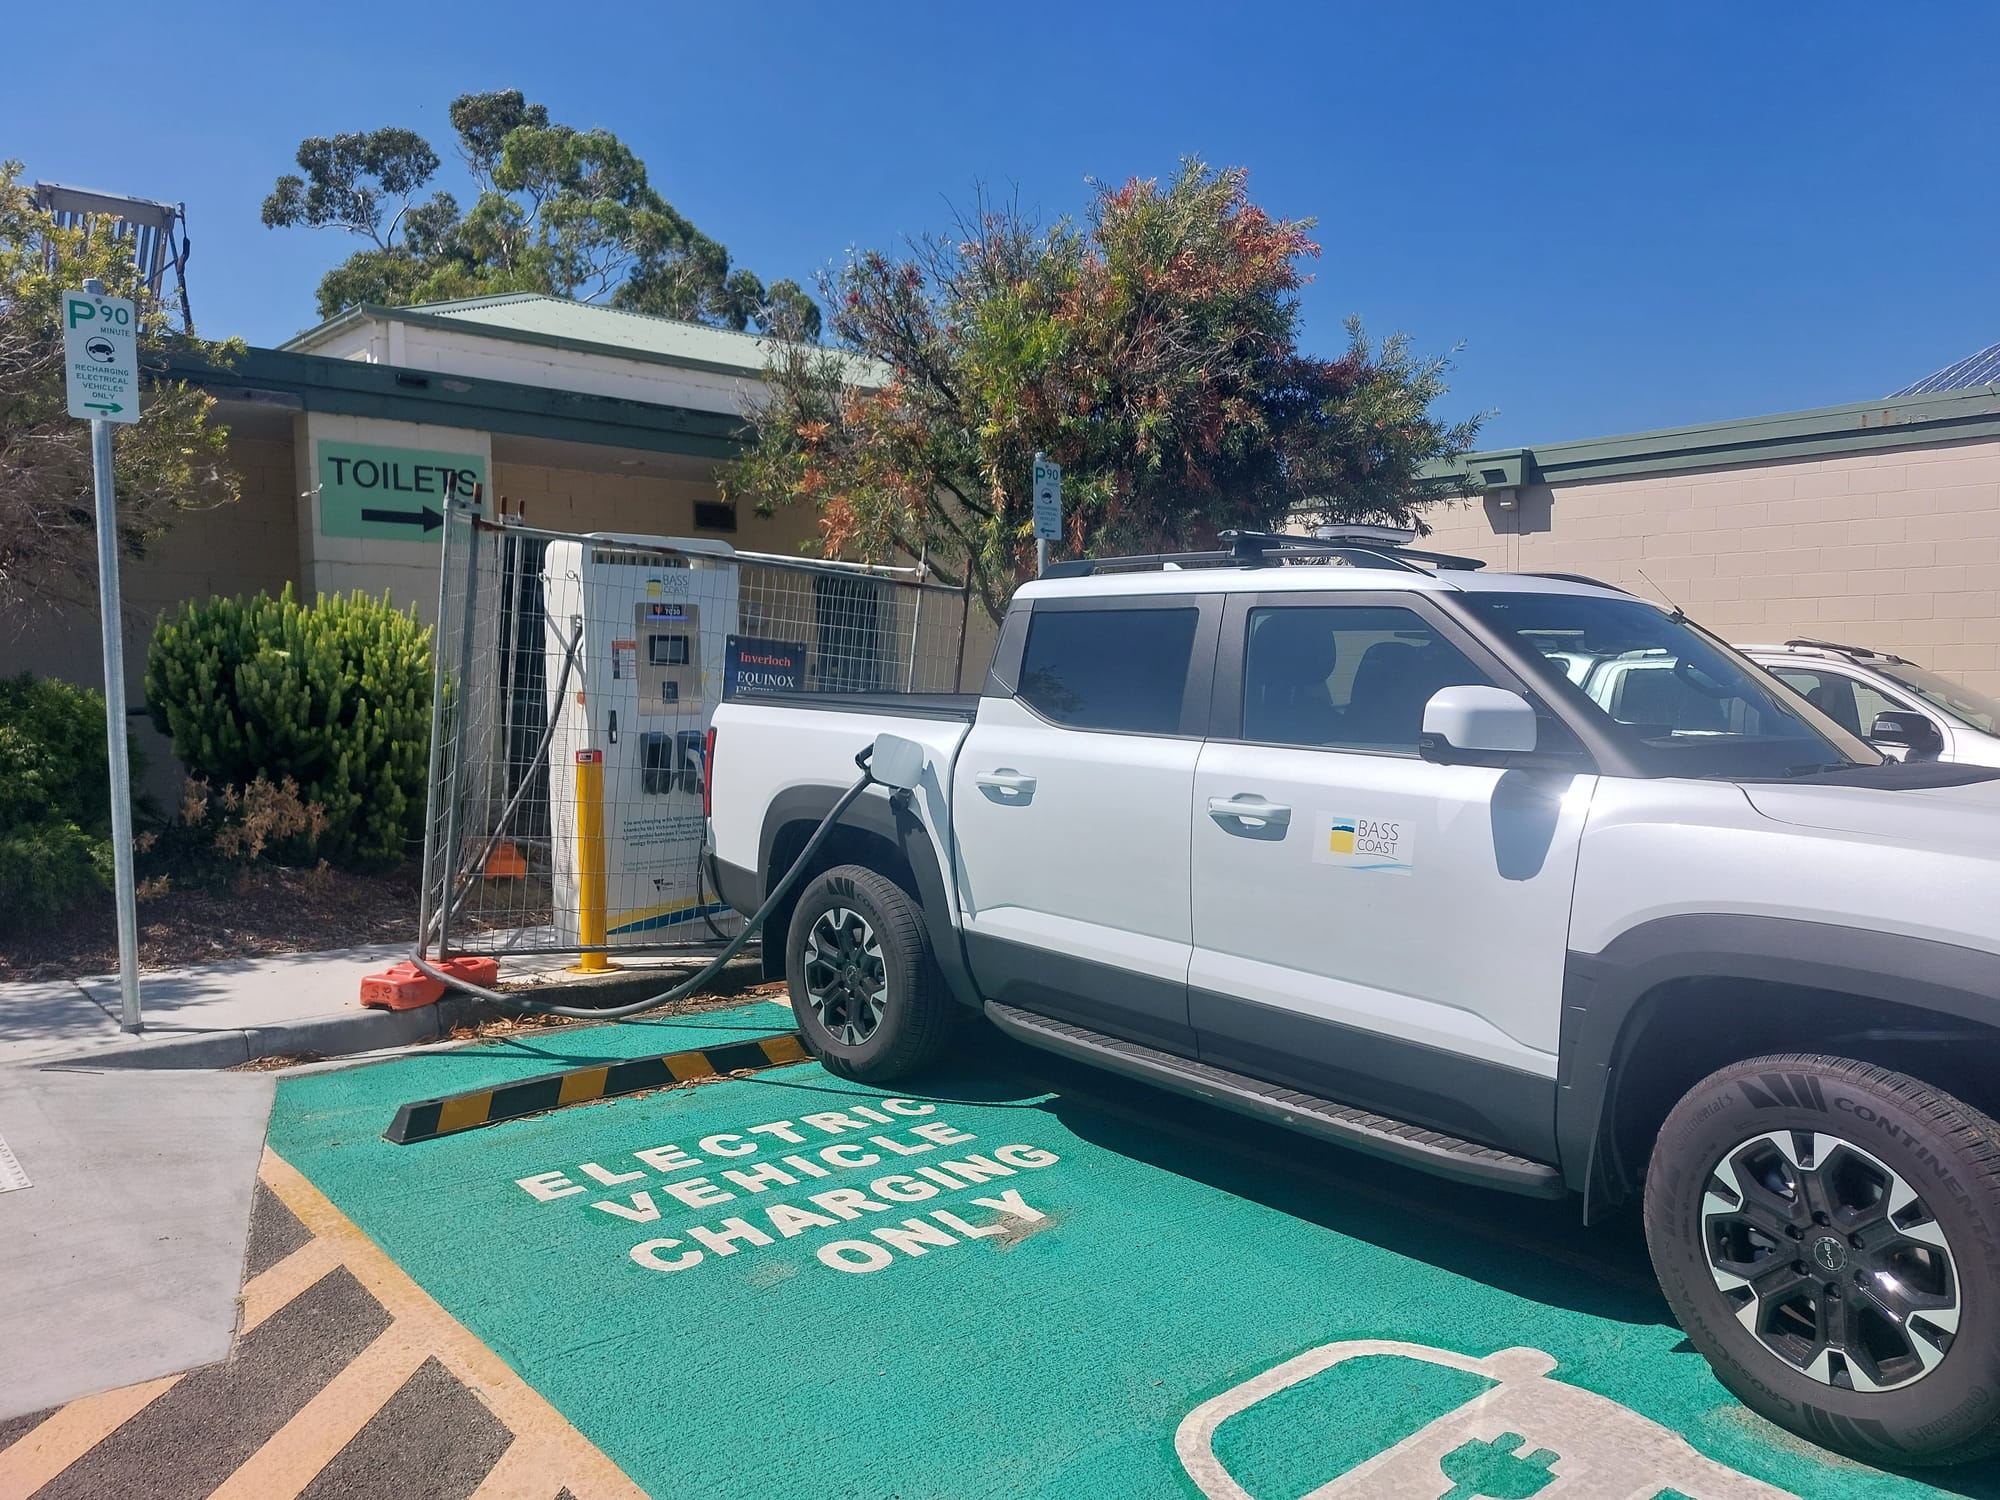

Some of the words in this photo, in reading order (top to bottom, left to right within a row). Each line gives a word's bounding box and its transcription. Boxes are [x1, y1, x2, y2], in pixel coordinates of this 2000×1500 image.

[69, 300, 95, 329] P
[100, 306, 129, 325] 90
[100, 327, 131, 337] MINUTE
[75, 364, 129, 376] RECHARGING
[76, 373, 129, 385] ELECTRICAL
[82, 382, 124, 393] VEHICLES
[92, 392, 115, 400] ONLY
[327, 456, 477, 497] TOILETS
[1036, 467, 1045, 484] P
[1047, 468, 1058, 480] 90
[663, 574, 688, 586] BASS
[740, 651, 791, 668] Inverloch
[737, 670, 795, 688] EQUINOX
[1358, 819, 1400, 841] BASS
[1357, 838, 1398, 855] COAST
[514, 1097, 936, 1202] ELECTRIC
[591, 1121, 977, 1224] VEHICLE
[629, 1144, 1061, 1273] CHARGING
[816, 1188, 1047, 1274] ONLY
